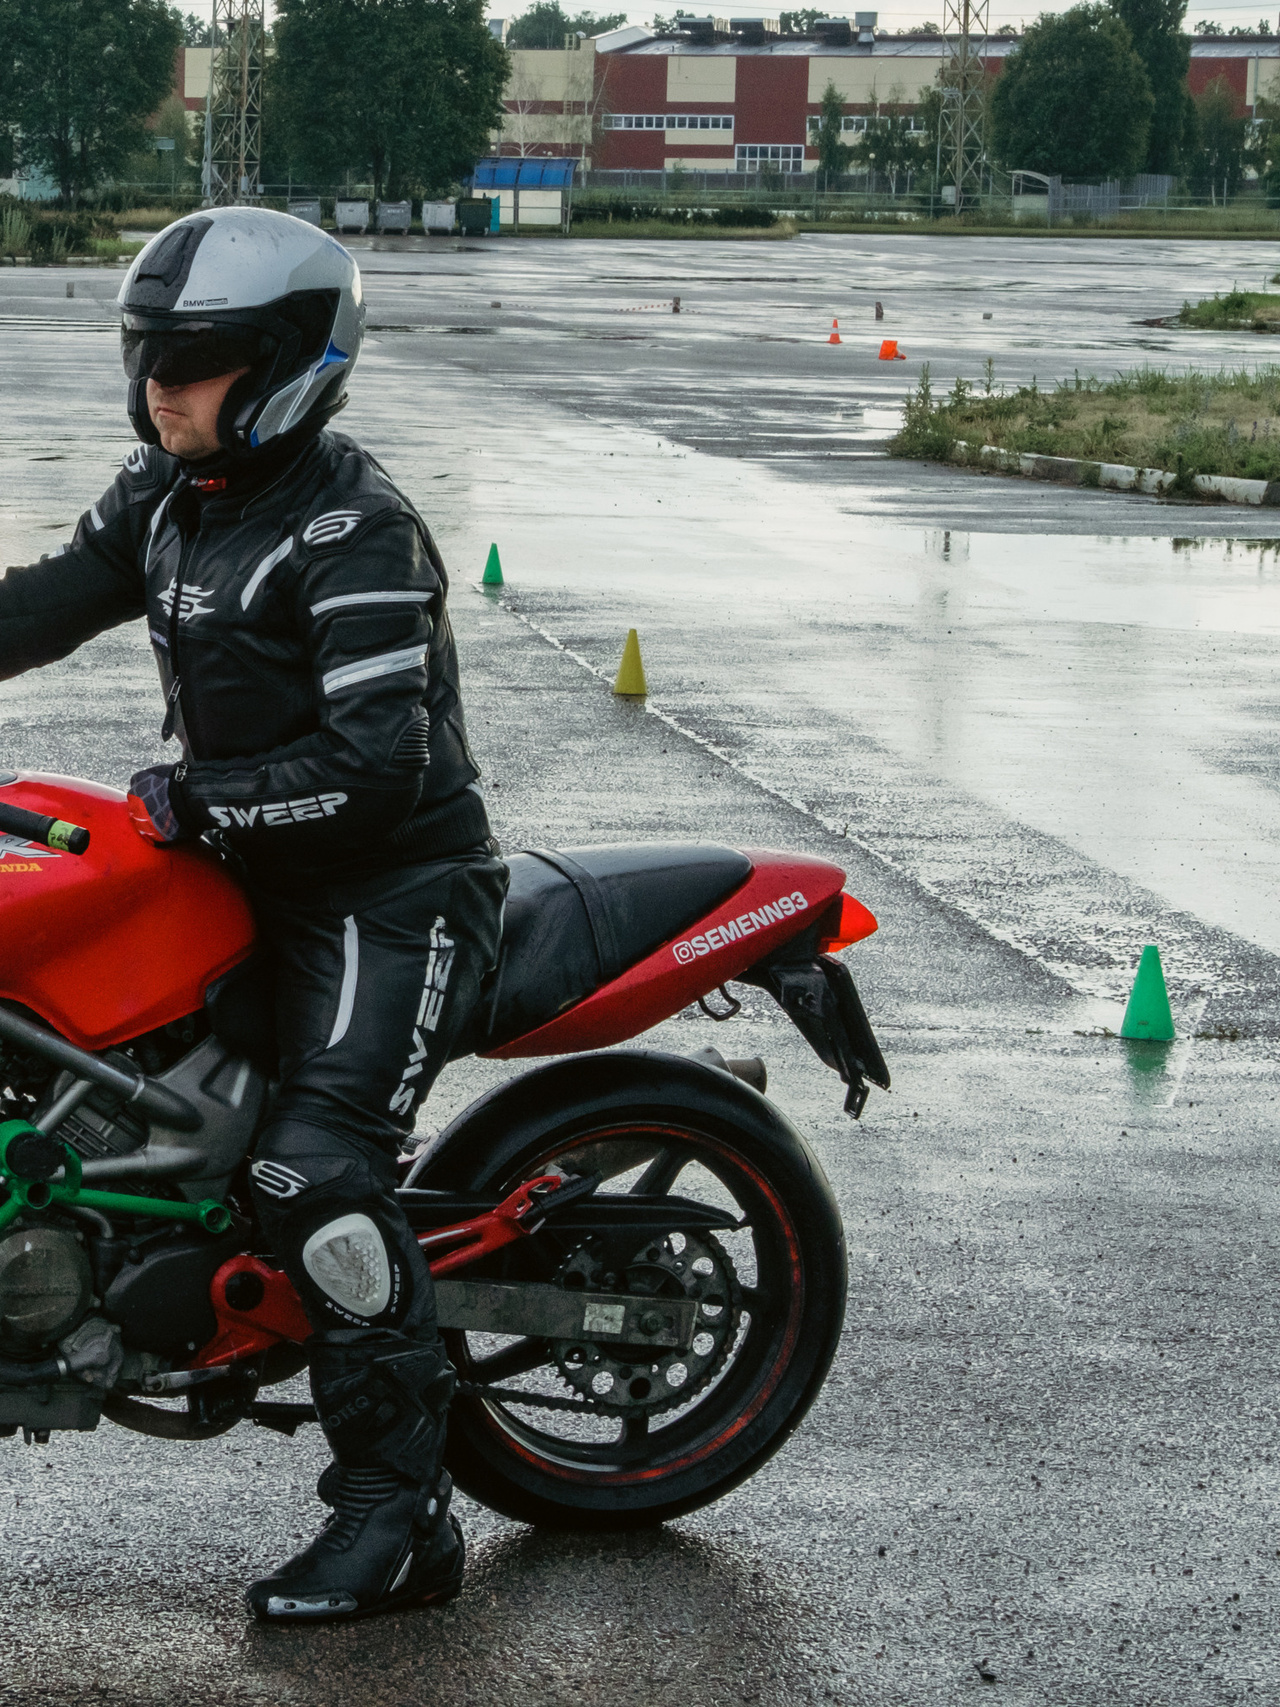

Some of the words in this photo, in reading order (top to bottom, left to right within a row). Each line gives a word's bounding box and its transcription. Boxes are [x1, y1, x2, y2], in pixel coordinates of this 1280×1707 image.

[208, 792, 349, 829] SWEEP
[388, 915, 456, 1117] SWEEP
[391, 1264, 400, 1313] SWEEP
[325, 1301, 370, 1327] SWEEP
